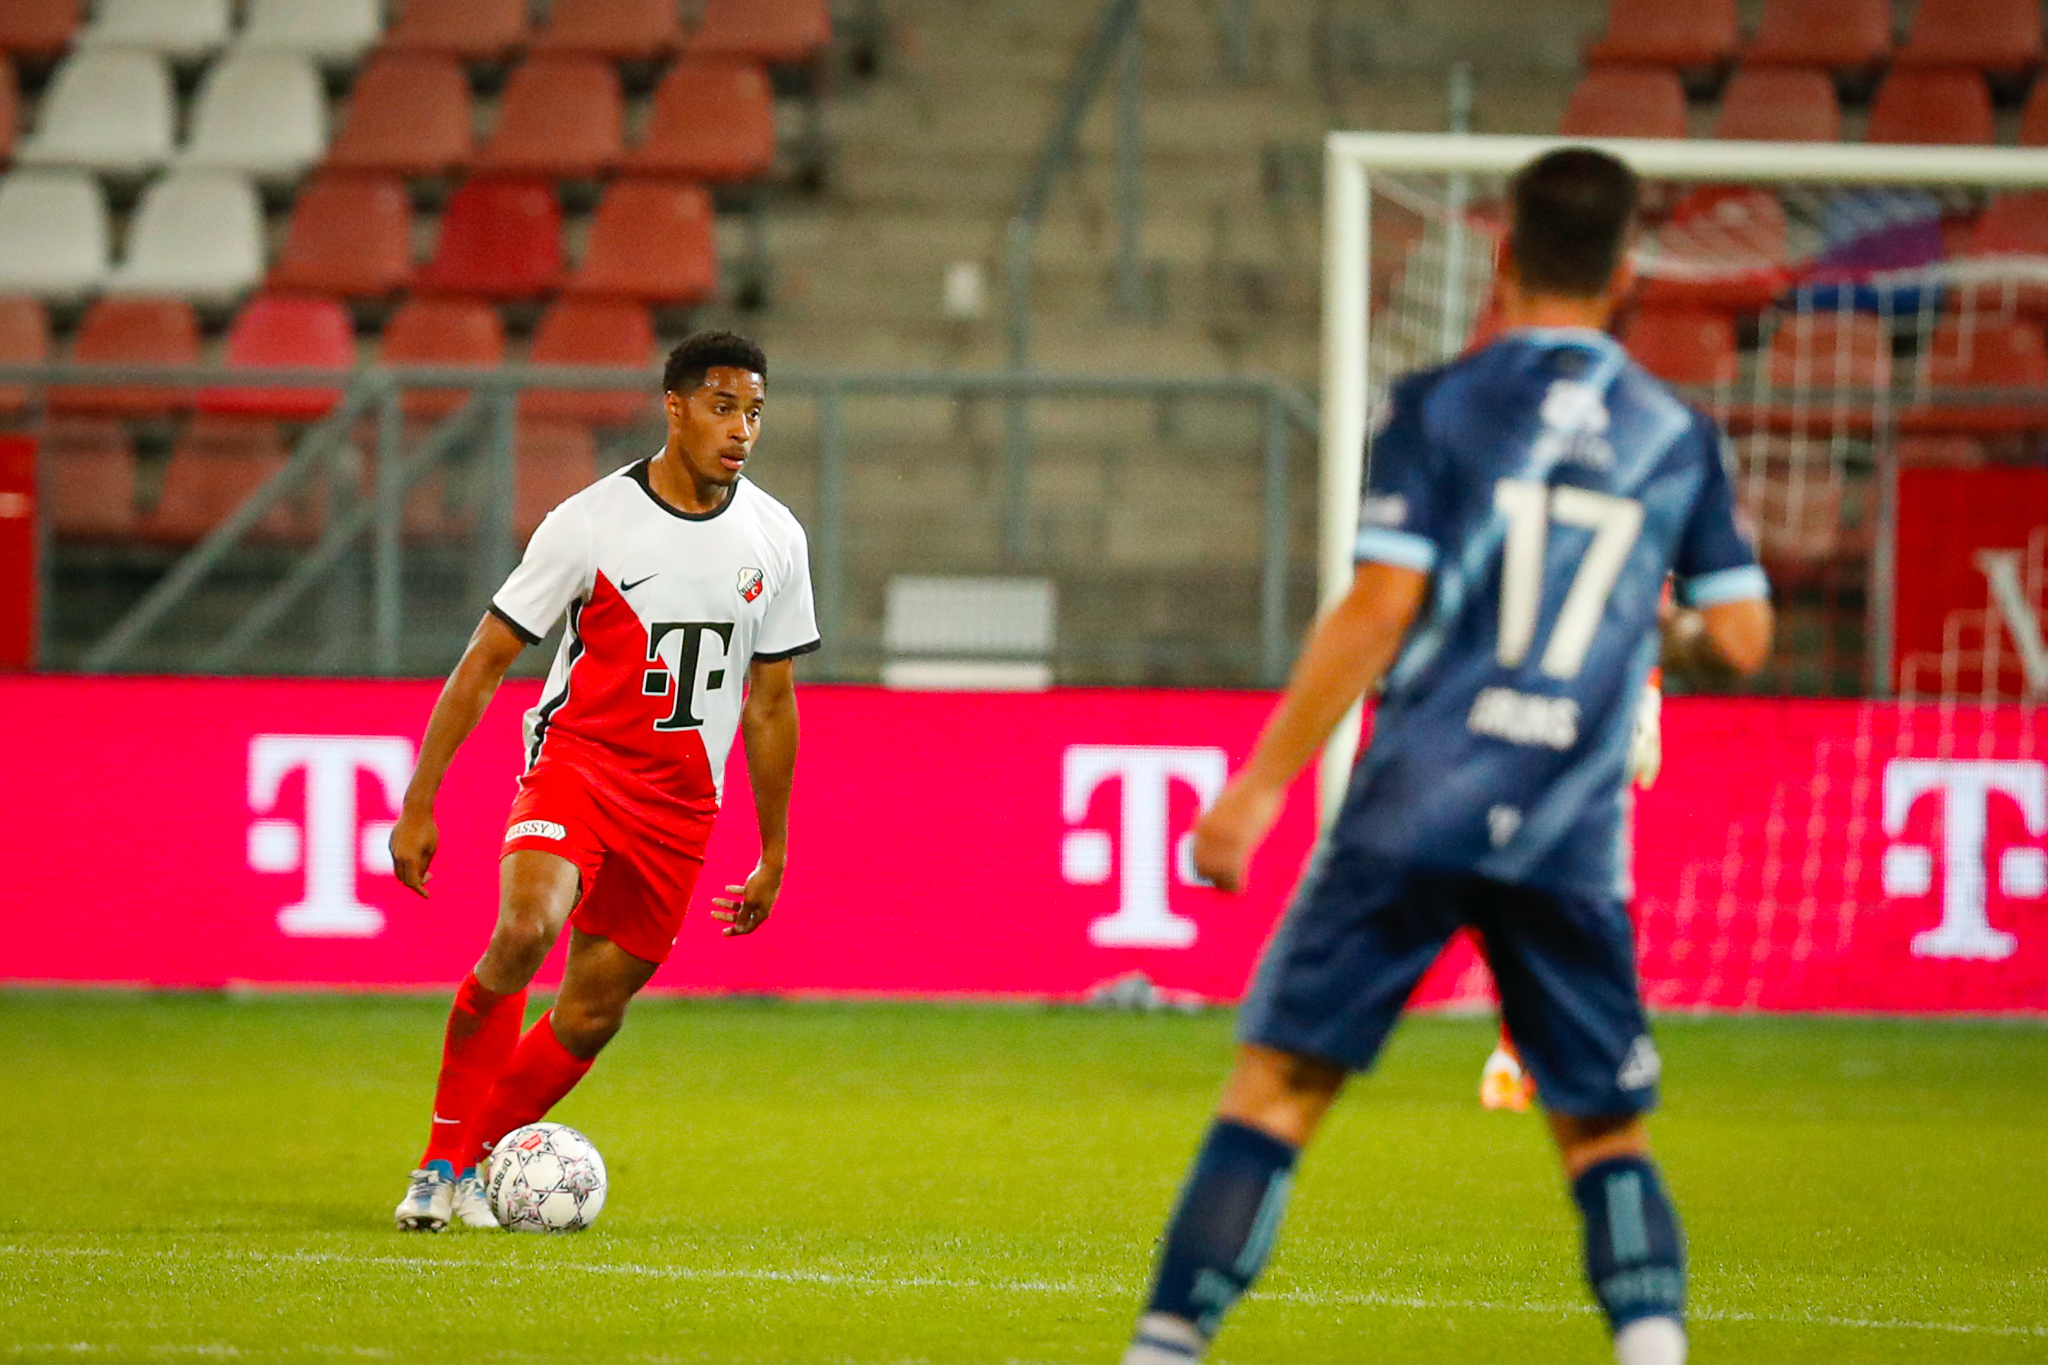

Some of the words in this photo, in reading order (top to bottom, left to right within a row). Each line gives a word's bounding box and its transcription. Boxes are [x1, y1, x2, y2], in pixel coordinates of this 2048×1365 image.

[645, 621, 735, 730] T
[1494, 478, 1645, 679] 17
[248, 734, 414, 938] T
[508, 823, 549, 838] ASSY
[1061, 745, 1228, 949] T
[1882, 758, 2048, 960] T
